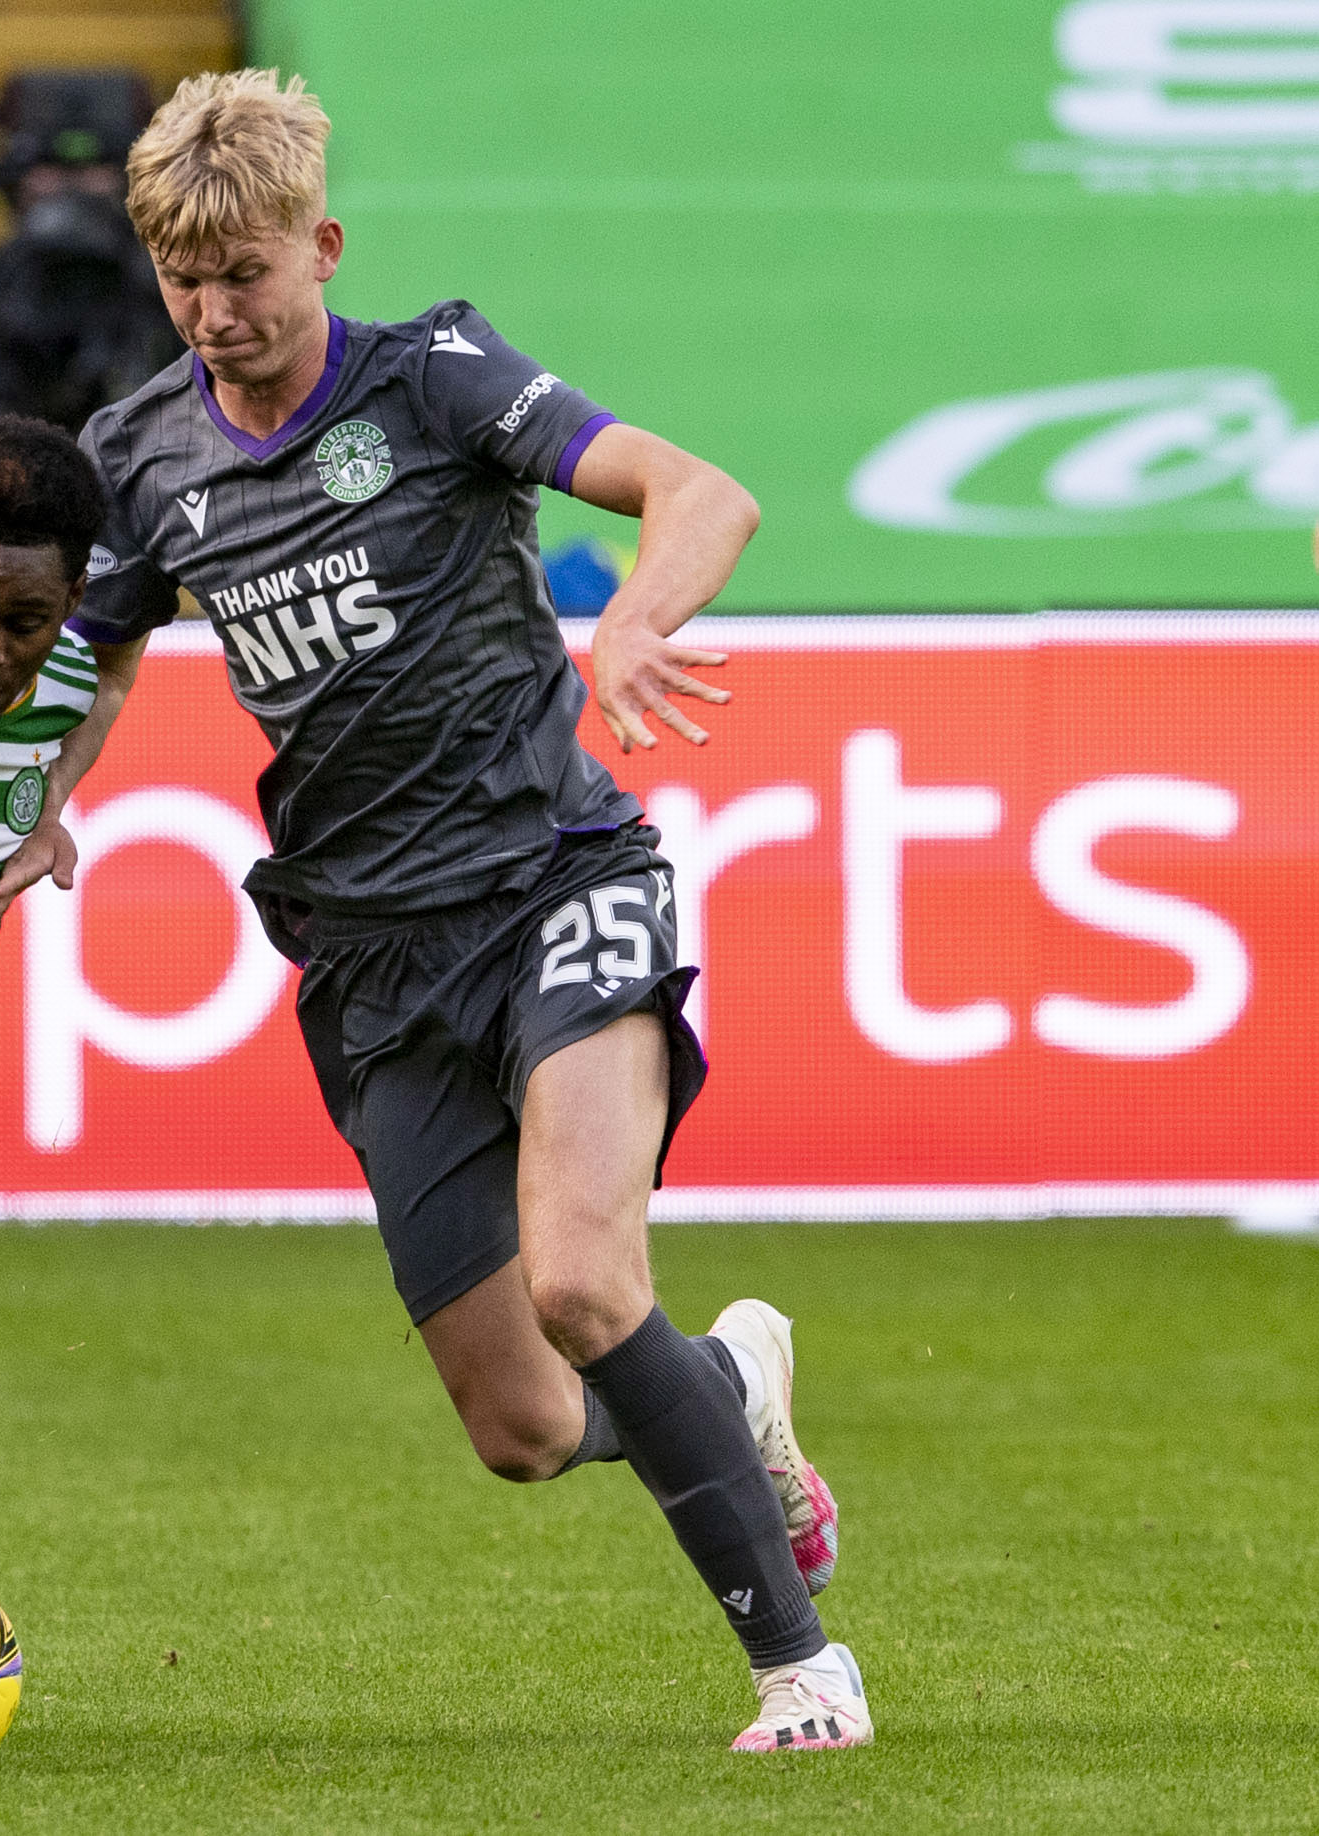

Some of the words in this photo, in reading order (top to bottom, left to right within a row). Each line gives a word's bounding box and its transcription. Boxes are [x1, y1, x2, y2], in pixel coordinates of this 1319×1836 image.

[319, 423, 380, 456] HIBERNIAN
[331, 469, 388, 499] EDINBURGH
[209, 567, 304, 620] THANK
[303, 546, 371, 590] YOU
[225, 579, 397, 686] NHS
[539, 885, 651, 994] 25
